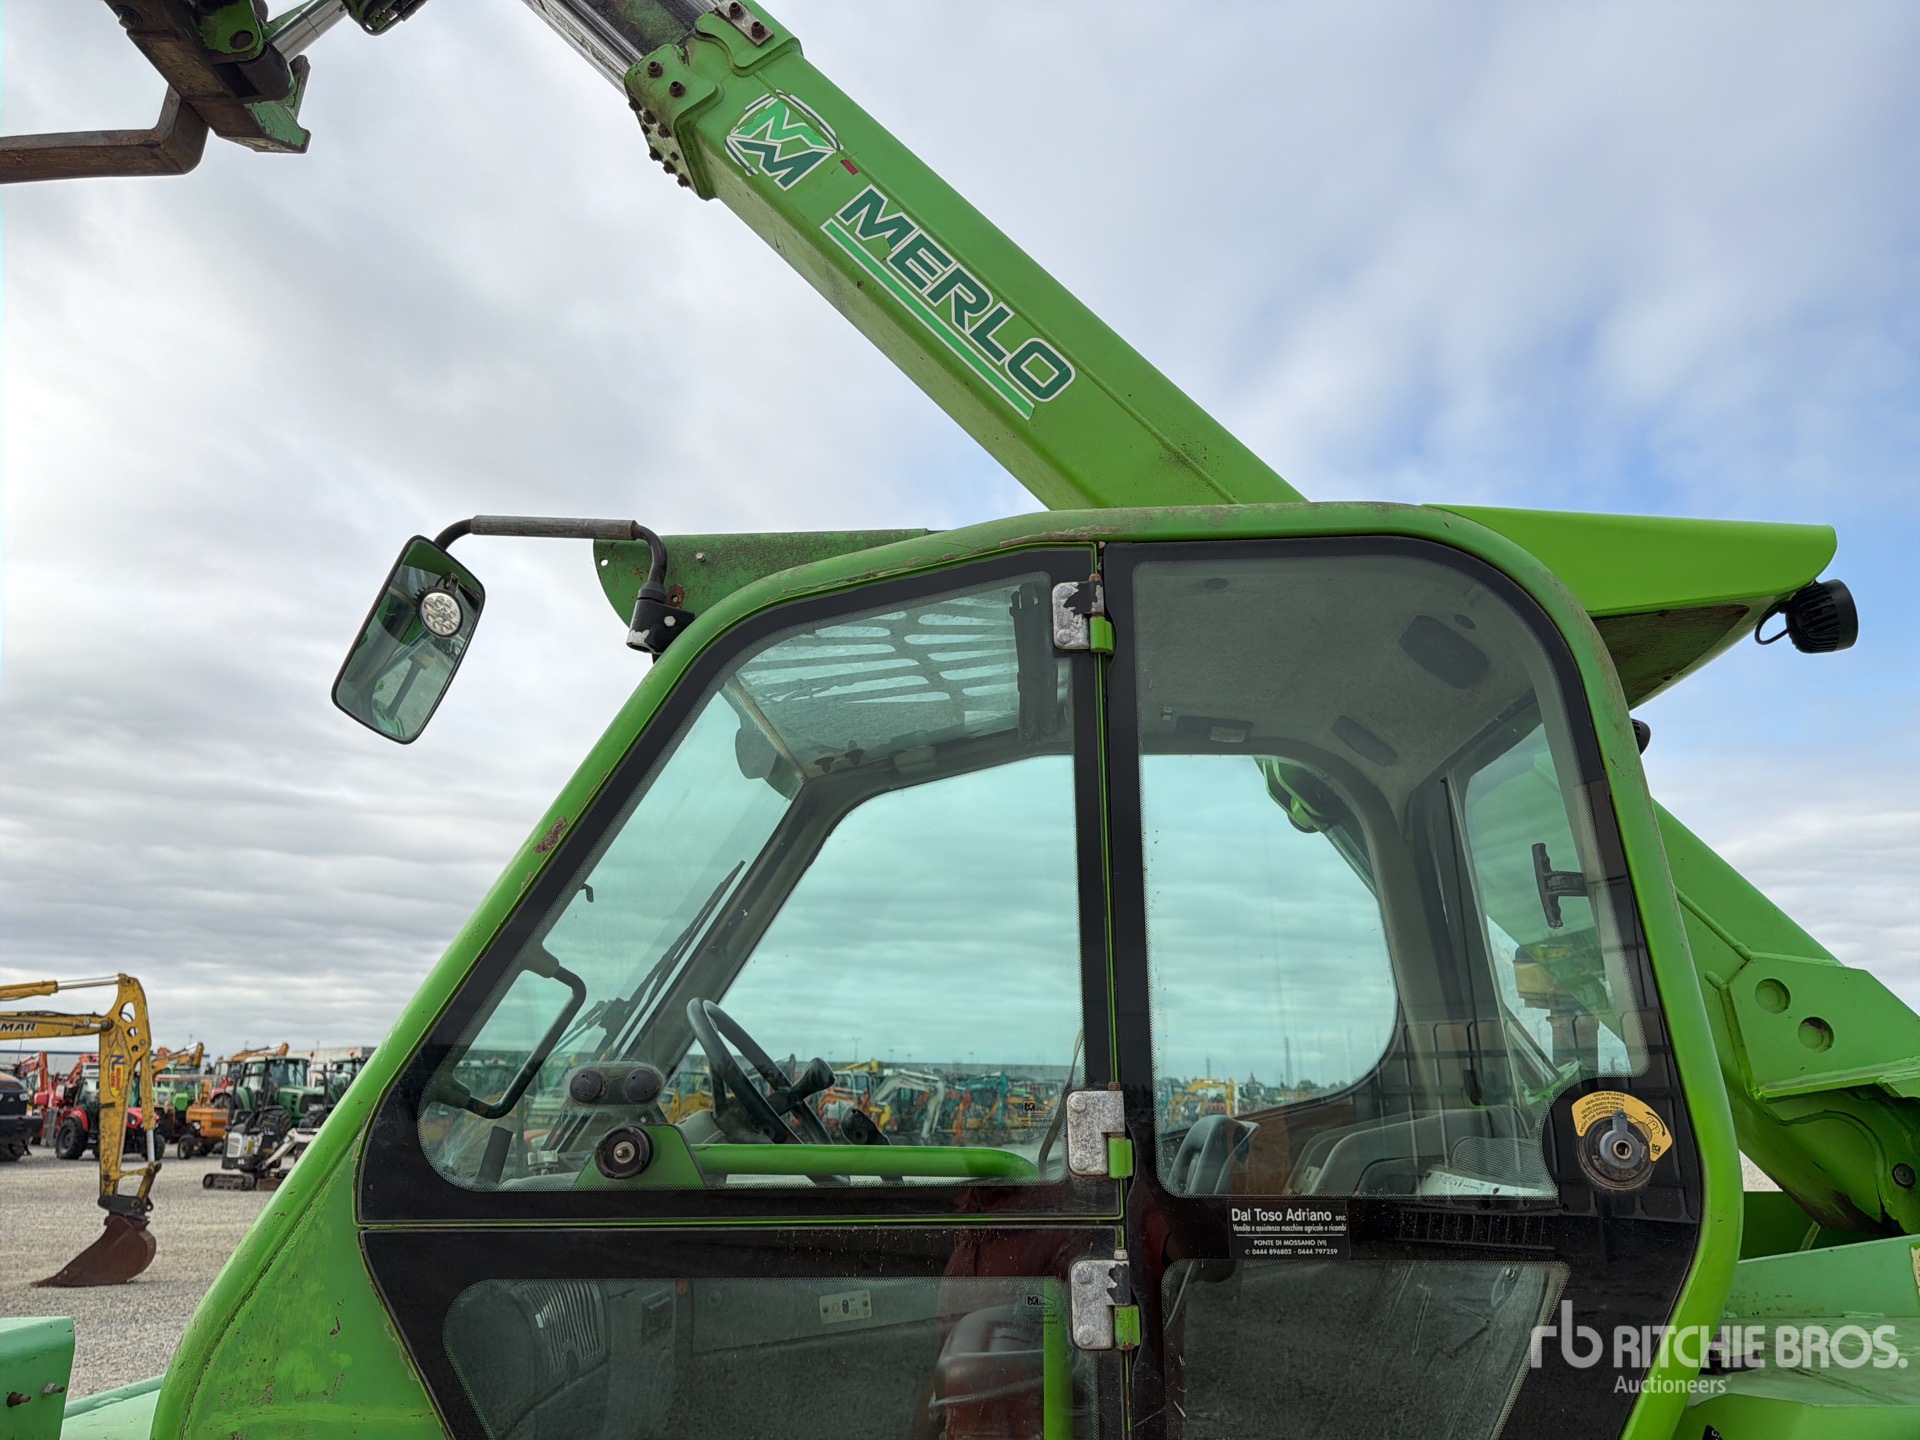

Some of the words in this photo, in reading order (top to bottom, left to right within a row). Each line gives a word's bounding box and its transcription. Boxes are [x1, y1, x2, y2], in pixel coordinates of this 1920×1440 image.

[835, 184, 1076, 402] MERLO
[1231, 1208, 1251, 1222] Dal
[1254, 1208, 1283, 1222] Toso
[1286, 1208, 1332, 1222] Adriano
[1232, 1224, 1251, 1232] Vendita
[1256, 1224, 1280, 1232] assistenza
[1281, 1223, 1303, 1232] macchine
[1304, 1223, 1324, 1234] agricole
[1328, 1223, 1347, 1232] ricambi
